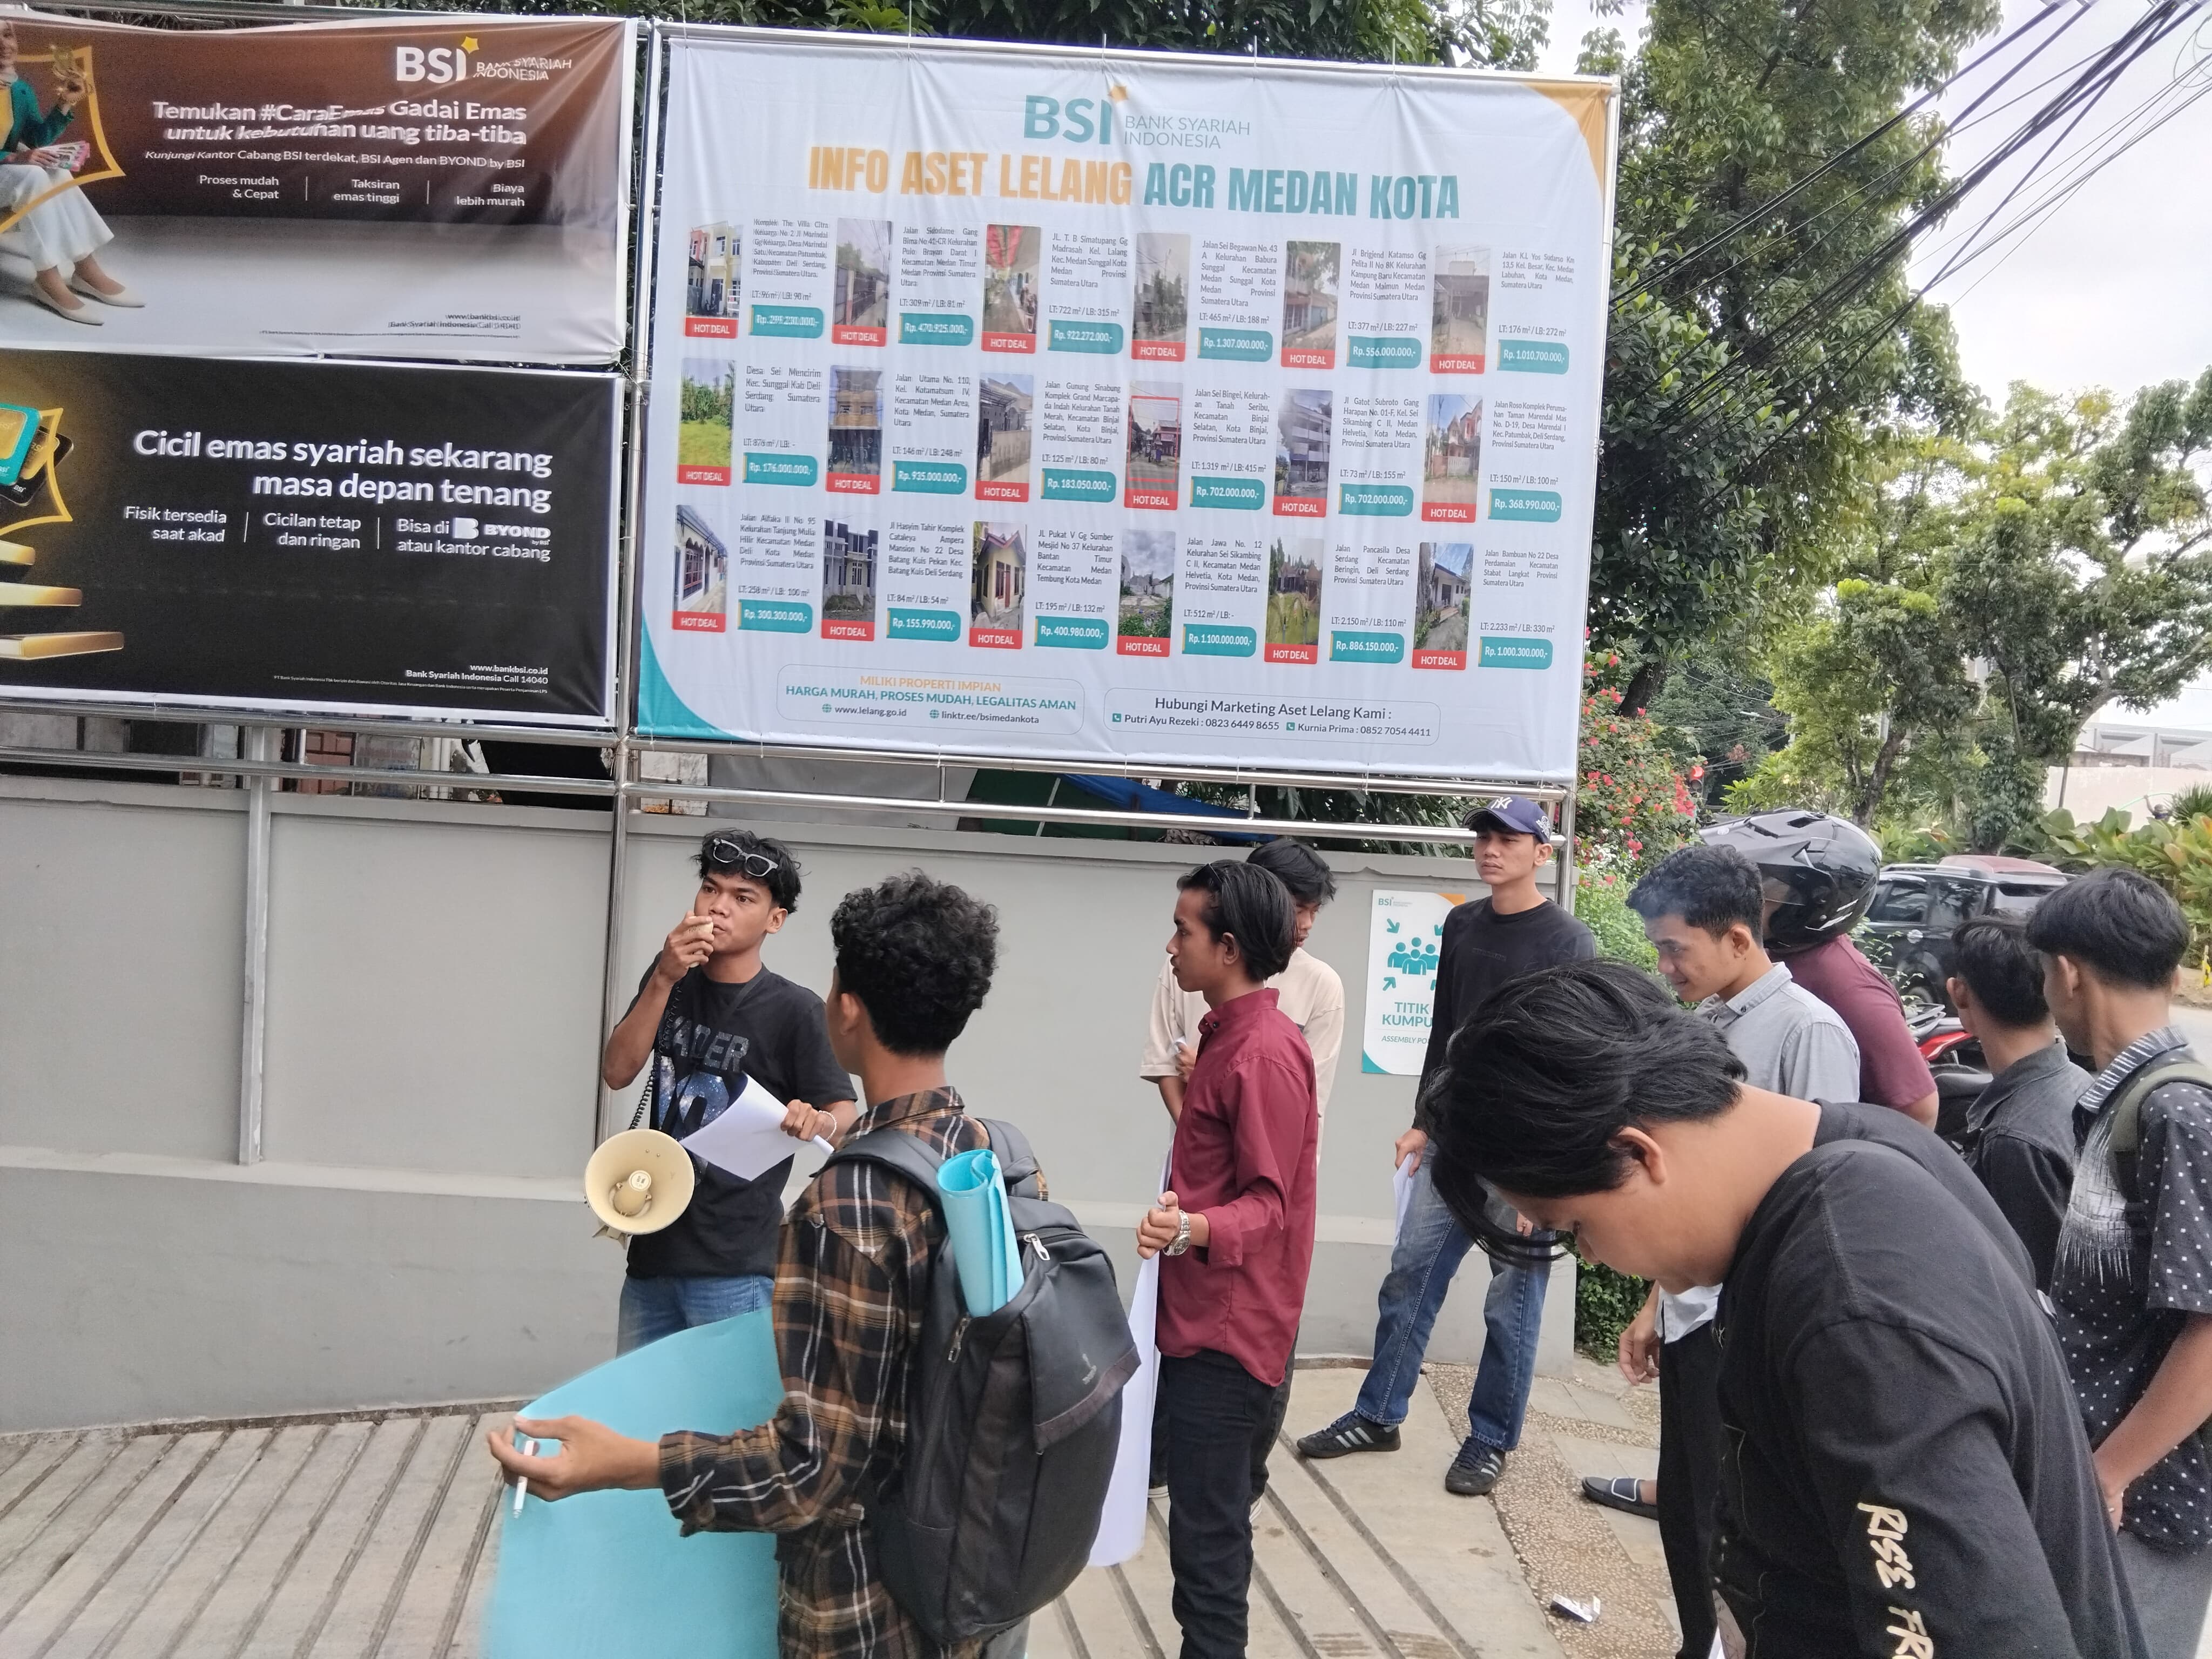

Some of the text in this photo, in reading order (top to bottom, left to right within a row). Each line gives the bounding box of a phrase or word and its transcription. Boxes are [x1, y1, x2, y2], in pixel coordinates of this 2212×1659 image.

[397, 46, 467, 83] BSI
[513, 57, 571, 70] SYARIAH
[473, 68, 549, 80] INDONESIA
[153, 99, 527, 122] Temukan #CaraEmas Gadai Emas
[1024, 95, 1112, 145] BSI
[1125, 115, 1250, 135] BANK SYARIAH
[165, 124, 527, 145] untuk kebutuhan uang tiba-tiba
[1124, 131, 1221, 149] INDONESIA
[145, 150, 524, 170] Kunjungi Kantor Cabang BSI terdekat, BSI Agen dan BYOND by BSI
[200, 175, 279, 185] Proses mudah
[352, 179, 399, 189] Taksiran
[808, 146, 1460, 220] INFO ASET LELANG ACR MEDAN KOTA
[233, 189, 279, 200] & Cepat
[493, 184, 524, 194] Biaya
[367, 193, 399, 204] tinggi
[456, 196, 524, 206] lebih murah
[1204, 337, 1268, 350] Rp. 1.307.000.000,-
[1353, 346, 1415, 358] Rp. 556.000.000,-
[134, 430, 552, 478] Cicil emas syariah sekarang
[253, 473, 551, 514] masa depan tenang
[1196, 487, 1259, 499] Rp. 702.000.000,-
[1345, 493, 1408, 505] Rp. 702.000.000,-
[1282, 503, 1318, 513] HOT DEAL
[1495, 498, 1560, 511] Rp. 368.990.000,-
[125, 506, 227, 523] Fisik tersedia
[263, 512, 361, 532] Cicilan tetap
[397, 518, 550, 538] Bisa di BYOND
[152, 528, 225, 542] saat akad
[278, 532, 360, 550] dan ringan
[397, 539, 550, 562] atau kantor cabang
[1363, 545, 1390, 554] Pancasila
[1335, 555, 1410, 564] Serdang Kecamatan
[1334, 565, 1360, 574] Beringin,
[1386, 568, 1409, 576] Serdang
[1334, 576, 1357, 584] Provinsi
[1359, 577, 1386, 585] Sumatera
[1041, 625, 1104, 638] Rp. 400.980.000,-
[1189, 633, 1252, 646] Rp. 1.100.000.000,-
[1336, 641, 1399, 653] Rp. 886.150.000,-
[1485, 646, 1548, 658] Rp. 1.000.300.000,-
[1273, 650, 1309, 660] HOT DEAL
[406, 670, 427, 678] Bank
[429, 671, 460, 680] Syariah
[462, 673, 501, 682] Indonesia
[470, 665, 548, 675] www.bankbsi.co.id
[860, 675, 1001, 692] MILIKI PROPERTI IMPIAN
[786, 685, 1076, 710] HARGA MURAH, PROSES MUDAH, LEGALITAS AMAN
[834, 706, 907, 718] www.lelang.go.id
[1155, 697, 1208, 712] Hubungi
[1211, 700, 1276, 716] Marketing
[1278, 704, 1307, 716] Aset
[1310, 705, 1351, 720] Lelang
[1353, 707, 1386, 719] Kami
[941, 711, 1040, 724] linktr.ee/bsimedankota
[1125, 714, 1147, 724] Putri
[1149, 716, 1166, 725] Ayu
[1169, 717, 1199, 726] Rezeki
[1205, 718, 1229, 727] 0823
[1231, 720, 1254, 729] 6449
[1256, 721, 1279, 730] 8655
[1298, 723, 1327, 732] Kurnia
[1328, 724, 1354, 733] Prima
[1360, 726, 1382, 734] 0852
[1384, 727, 1407, 735] 7054
[1408, 727, 1431, 736] 4411
[1378, 898, 1392, 906] BSI
[1394, 1002, 1429, 1014] TITIK
[1382, 1014, 1432, 1028] KUMPU
[1381, 1035, 1416, 1043] ASSEMBLY
[1857, 1502, 1934, 1659] RISE FR
